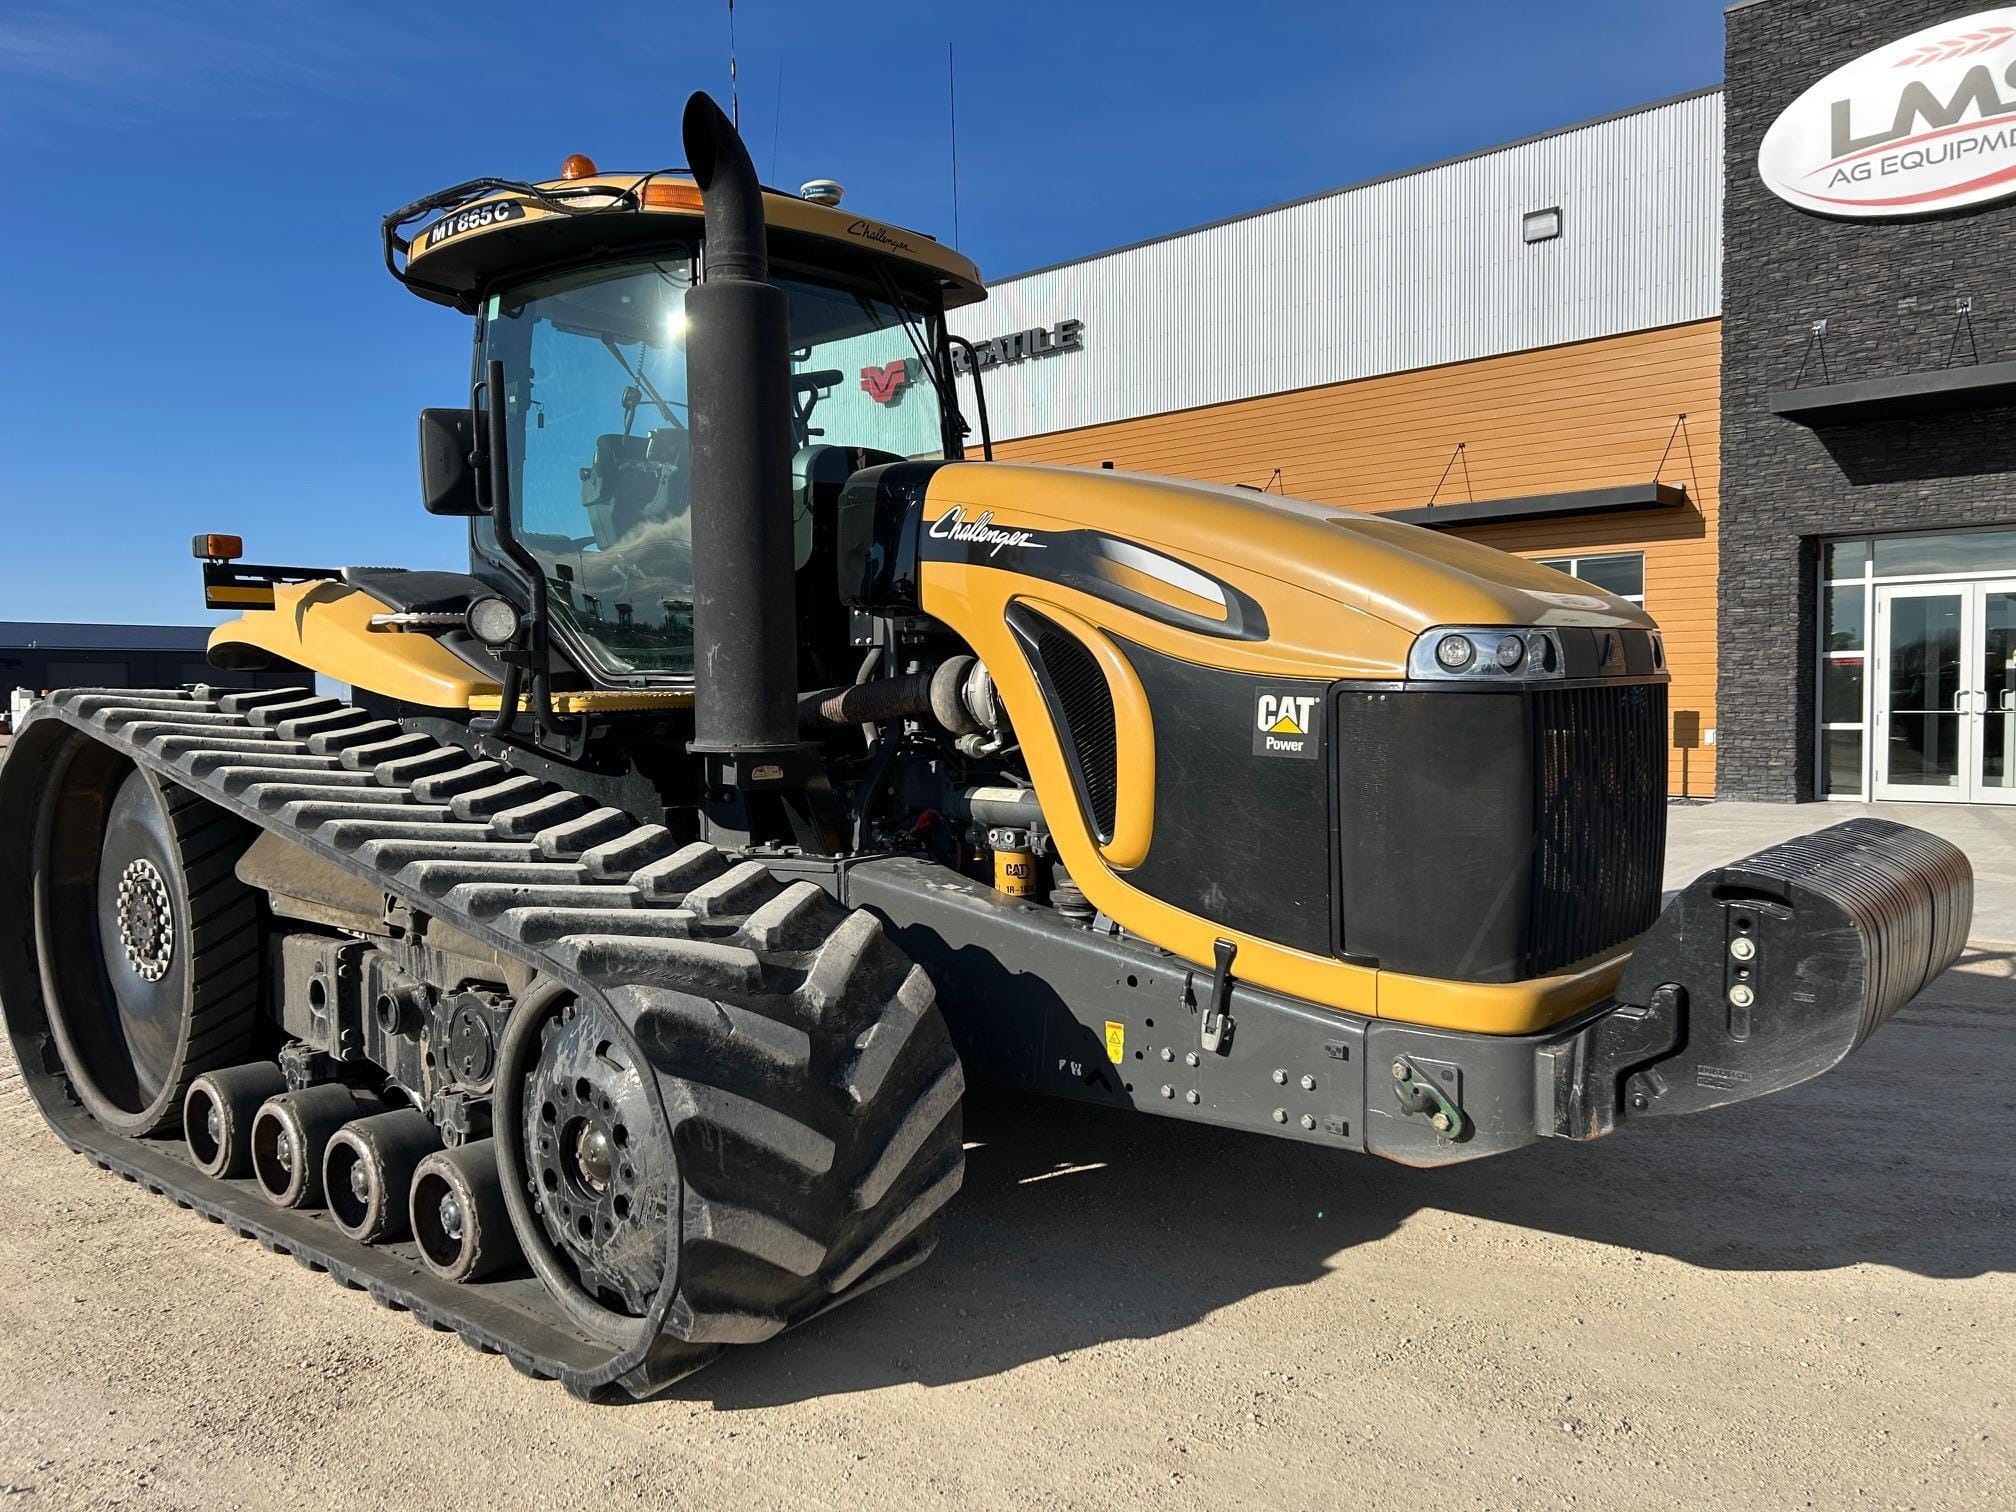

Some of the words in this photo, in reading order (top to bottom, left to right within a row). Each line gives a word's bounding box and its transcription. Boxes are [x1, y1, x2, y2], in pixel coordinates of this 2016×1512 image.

[1828, 161, 1872, 188] AG
[846, 220, 919, 253] Challenger
[929, 504, 1047, 558] Challenger
[1257, 694, 1315, 735] CAT
[1265, 736, 1304, 752] Power
[1005, 863, 1027, 878] CAT
